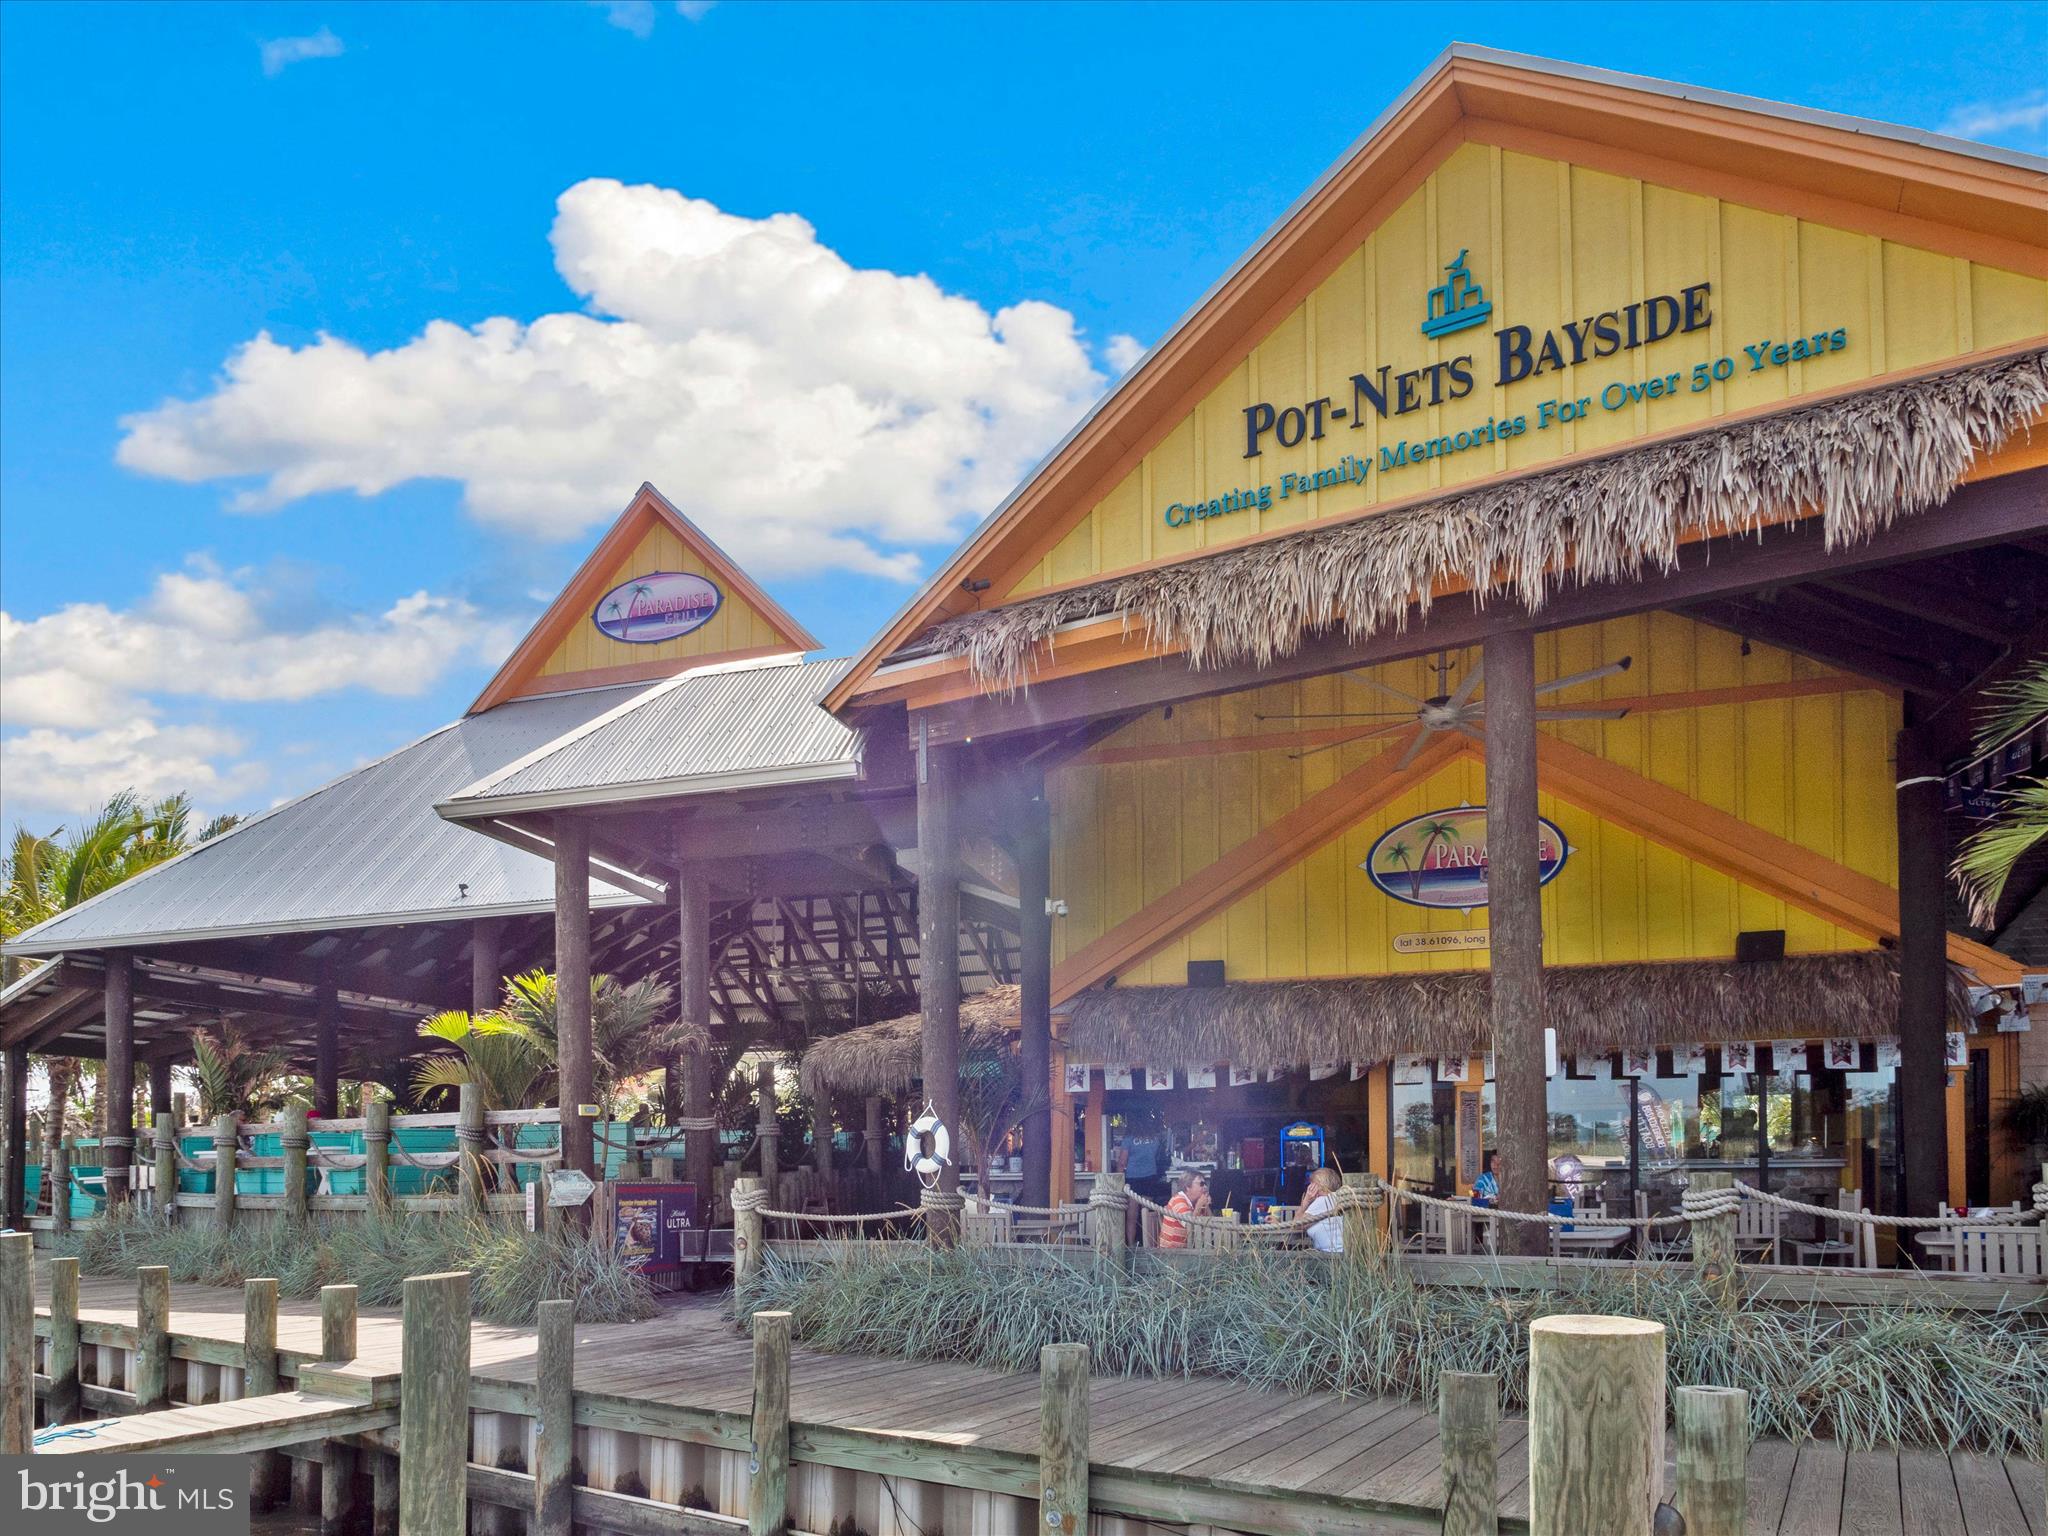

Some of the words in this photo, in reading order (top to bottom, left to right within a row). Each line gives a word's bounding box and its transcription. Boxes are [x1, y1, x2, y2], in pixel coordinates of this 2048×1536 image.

[1164, 484, 1272, 529] Creating
[1280, 454, 1371, 499] Family
[1380, 416, 1526, 471] Memories
[1537, 398, 1591, 429] For
[1601, 373, 1681, 411] Over
[1691, 357, 1735, 391] 50
[1744, 328, 1848, 372] Years
[638, 592, 709, 616] PARADISE
[1435, 839, 1548, 869] PARAE
[1400, 939, 1412, 947] lat
[1464, 935, 1486, 944] long
[666, 1217, 691, 1229] ULTRA
